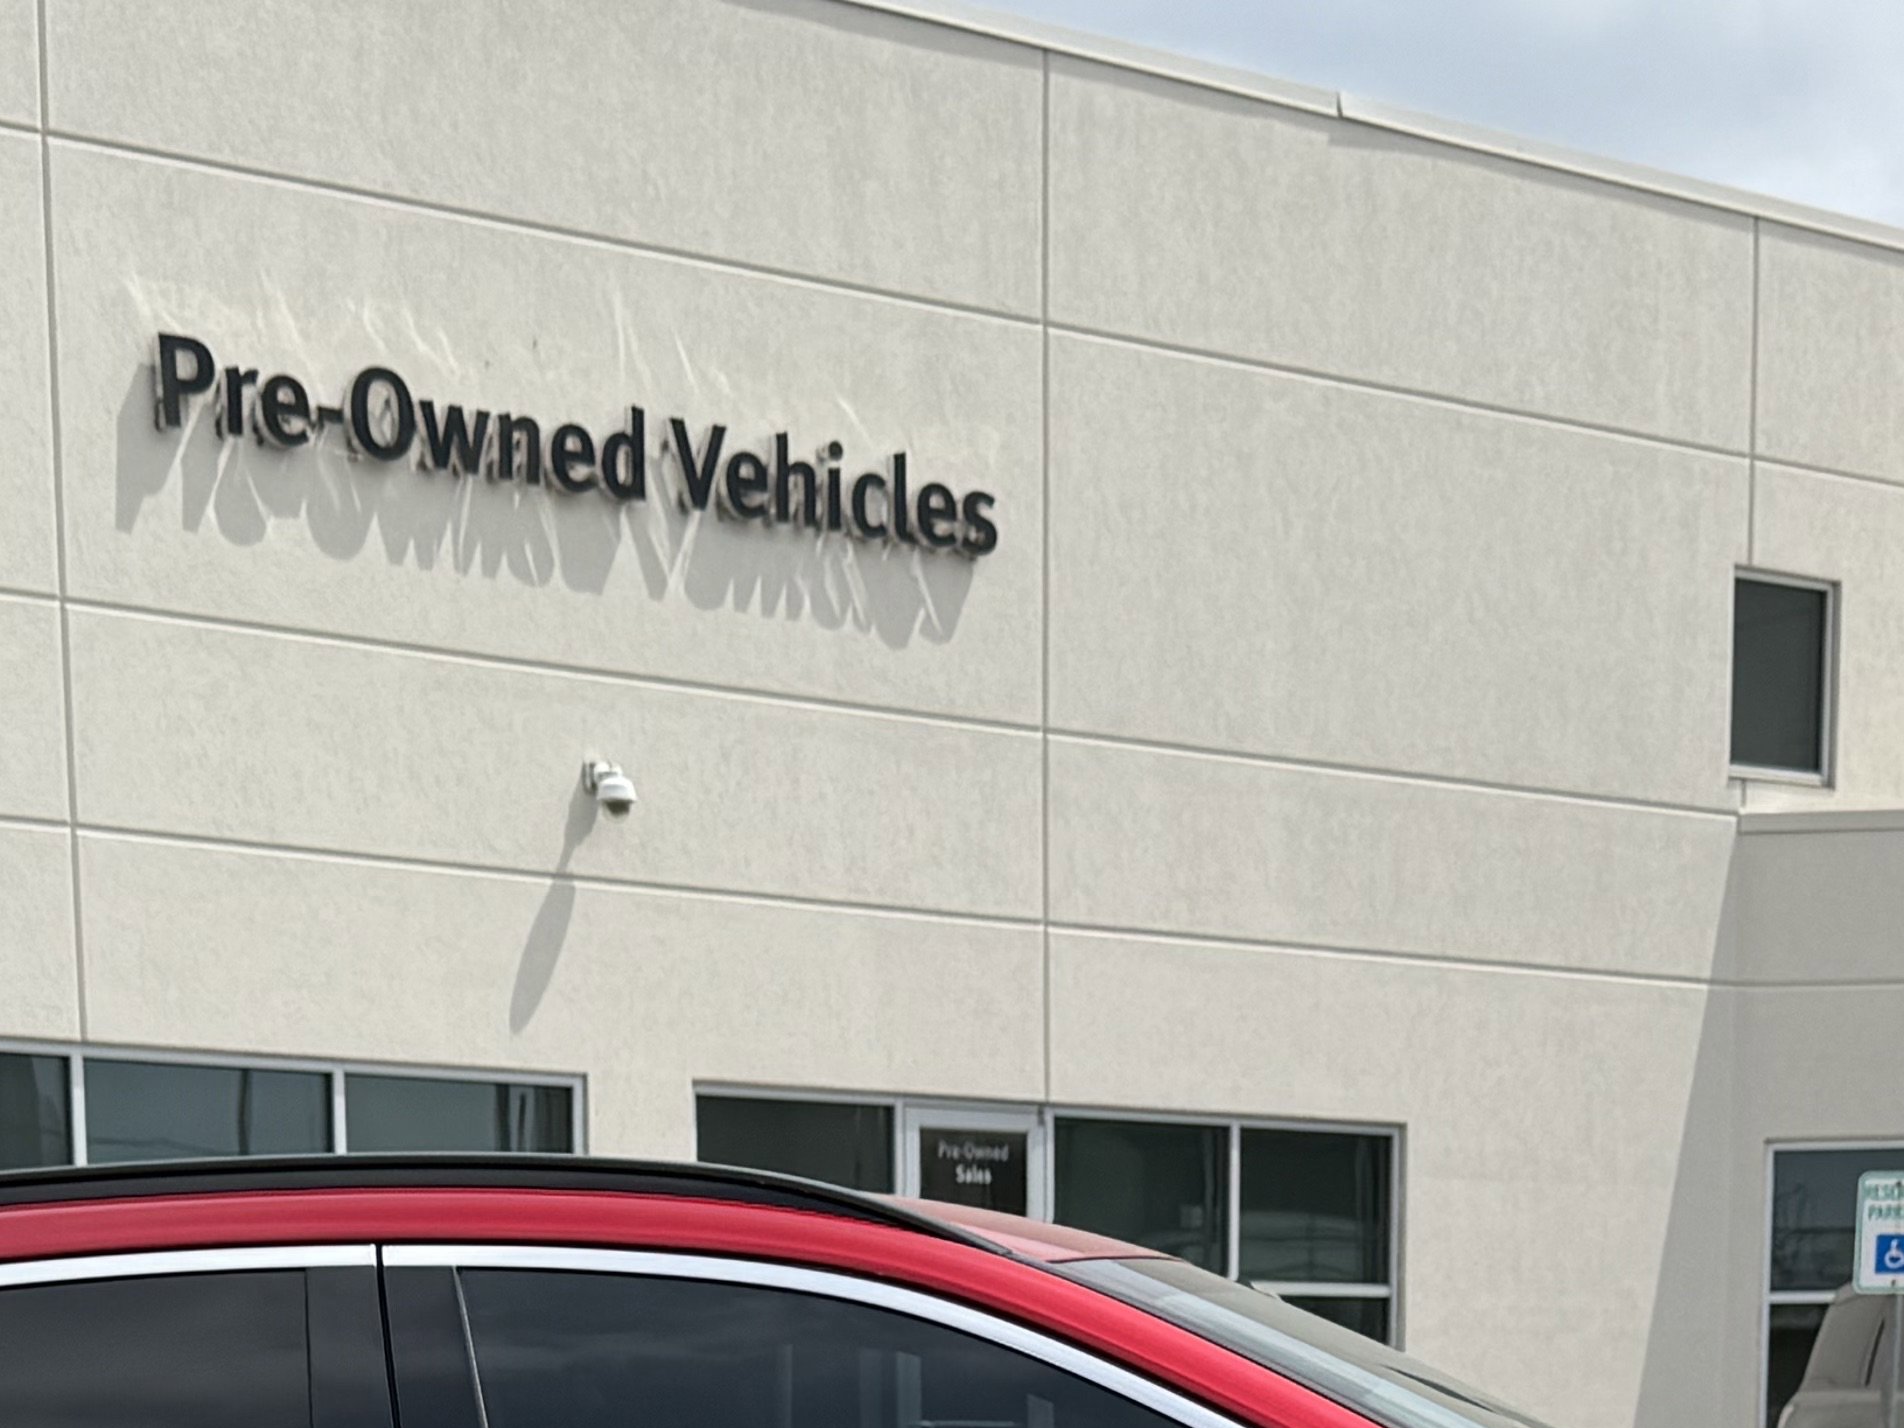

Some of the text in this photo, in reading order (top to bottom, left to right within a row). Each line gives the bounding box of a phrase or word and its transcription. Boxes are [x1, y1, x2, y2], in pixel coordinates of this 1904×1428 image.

[155, 332, 999, 556] Pre-Owned Vehicles
[938, 1140, 1009, 1162] Pre-Owned
[955, 1164, 993, 1185] Sales
